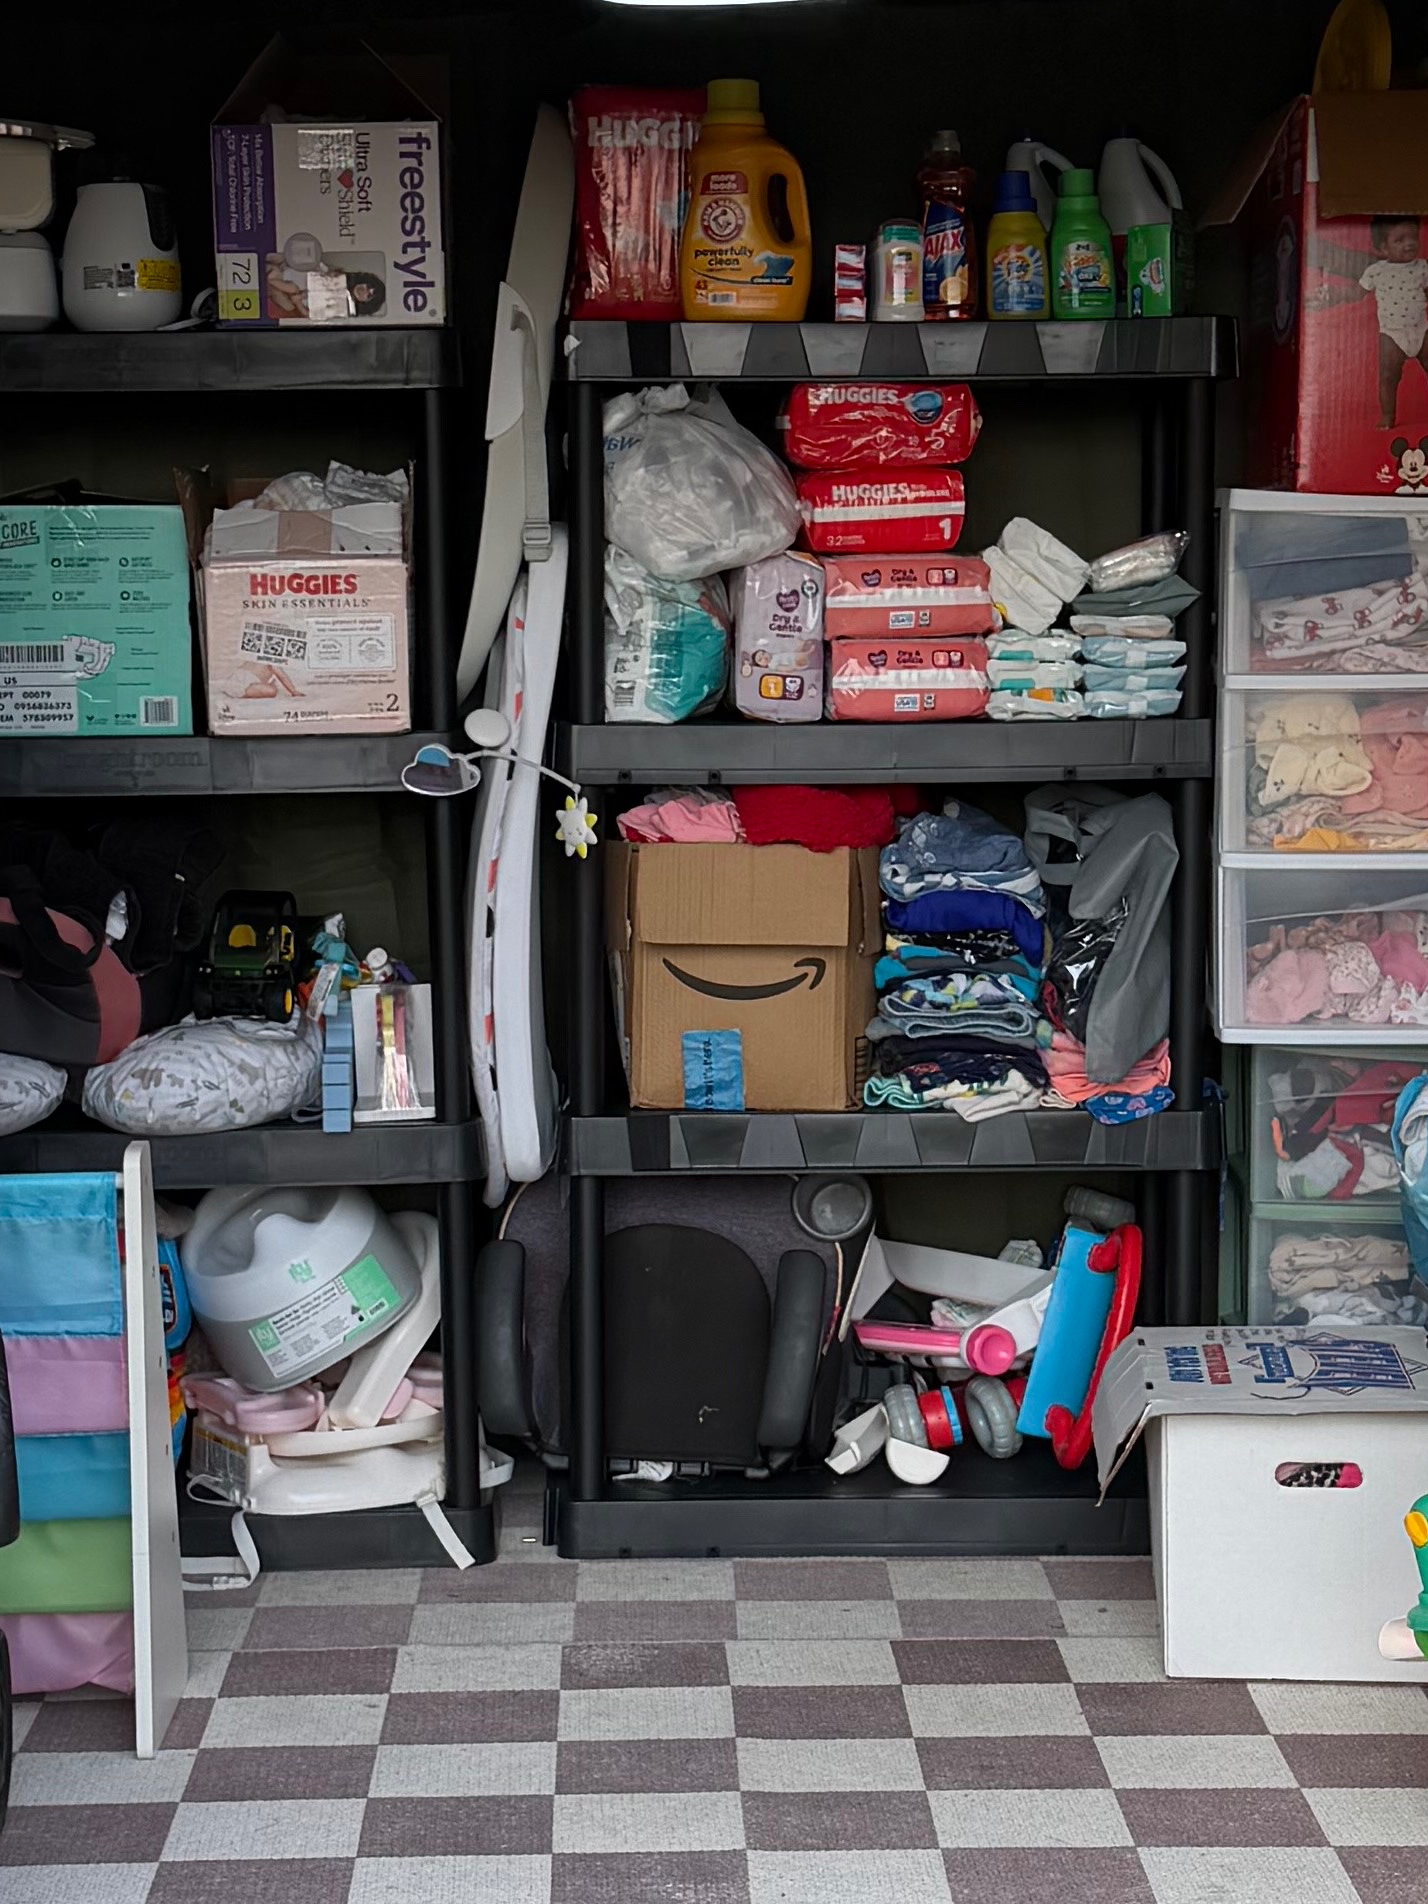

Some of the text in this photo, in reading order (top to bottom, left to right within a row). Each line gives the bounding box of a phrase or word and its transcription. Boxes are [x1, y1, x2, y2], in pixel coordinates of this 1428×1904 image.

[354, 132, 373, 214] Ultra Soft
[337, 188, 355, 238] Shield
[393, 131, 436, 313] freestyle
[694, 247, 755, 260] powerfully
[924, 230, 962, 257] AJAX
[231, 257, 251, 285] 72
[707, 256, 740, 267] clean
[233, 296, 252, 312] 3
[831, 482, 910, 501] HUGGIES
[1, 520, 38, 541] CORE
[938, 517, 952, 541] 1
[249, 572, 359, 597] HUGGIES
[241, 598, 369, 610] SKIN ESSENTIALS
[3, 676, 18, 686] US
[386, 693, 400, 713] 2
